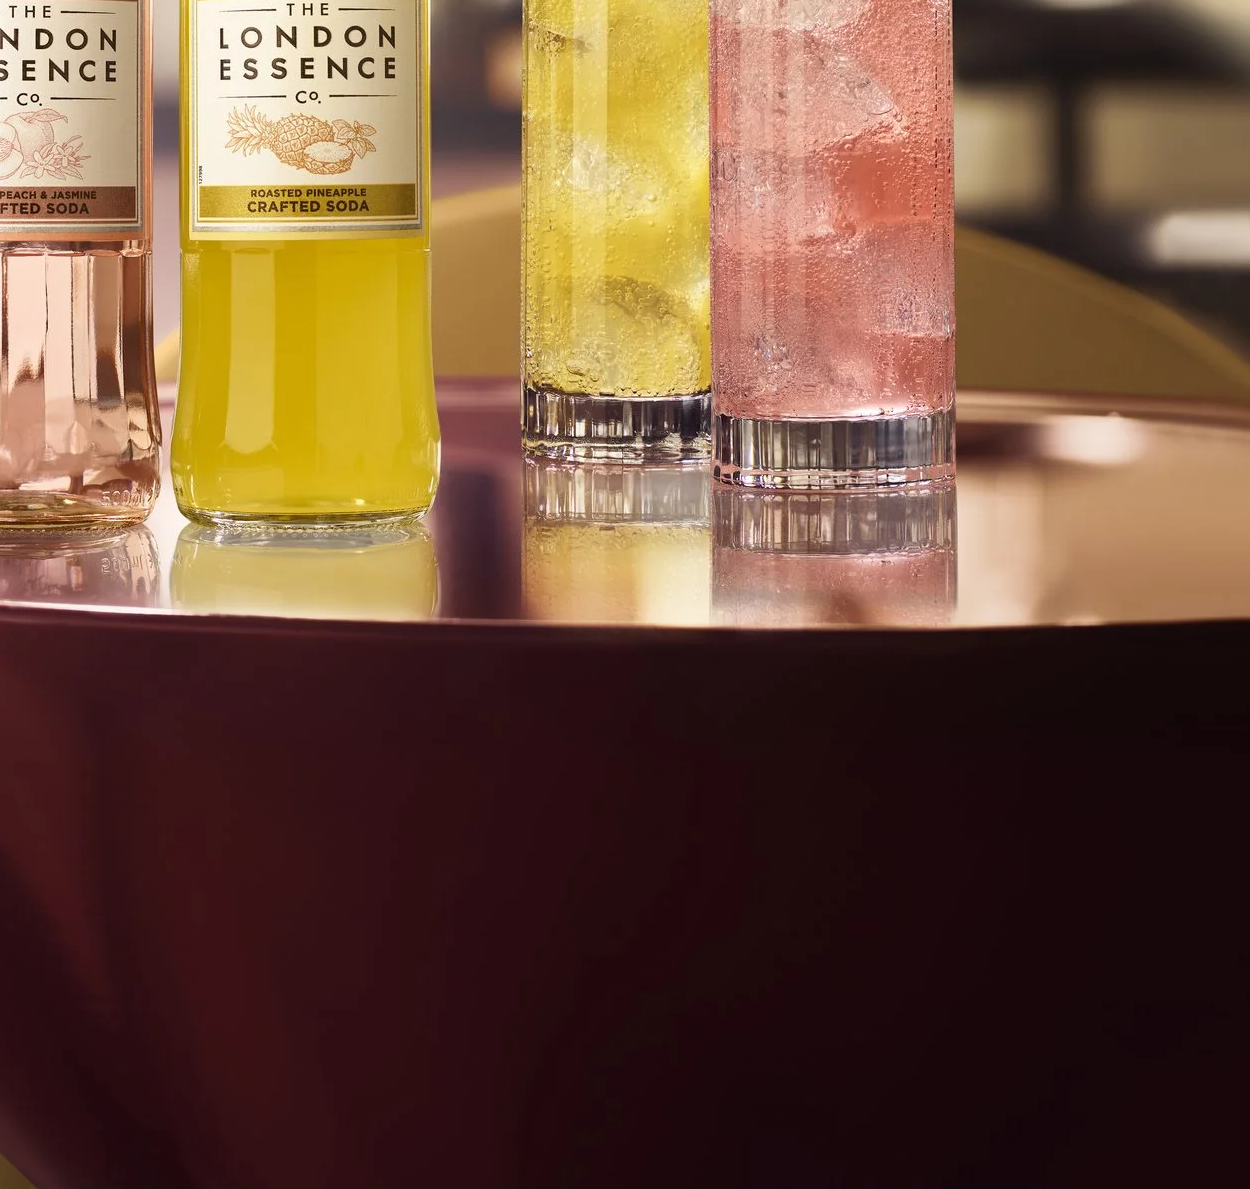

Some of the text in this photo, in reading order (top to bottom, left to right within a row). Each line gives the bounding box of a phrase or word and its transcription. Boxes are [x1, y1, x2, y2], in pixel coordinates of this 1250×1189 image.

[8, 5, 52, 19] THE
[286, 2, 329, 17] THE
[219, 24, 396, 50] LONDON
[219, 56, 396, 80] ESSENCE
[0, 190, 37, 200] PEACH
[40, 191, 48, 200] &
[51, 190, 97, 200] JASMINE
[250, 188, 367, 198] ROASTED PINEAPPLE
[46, 202, 89, 215] SODA
[247, 199, 370, 213] CRAFTED SODA
